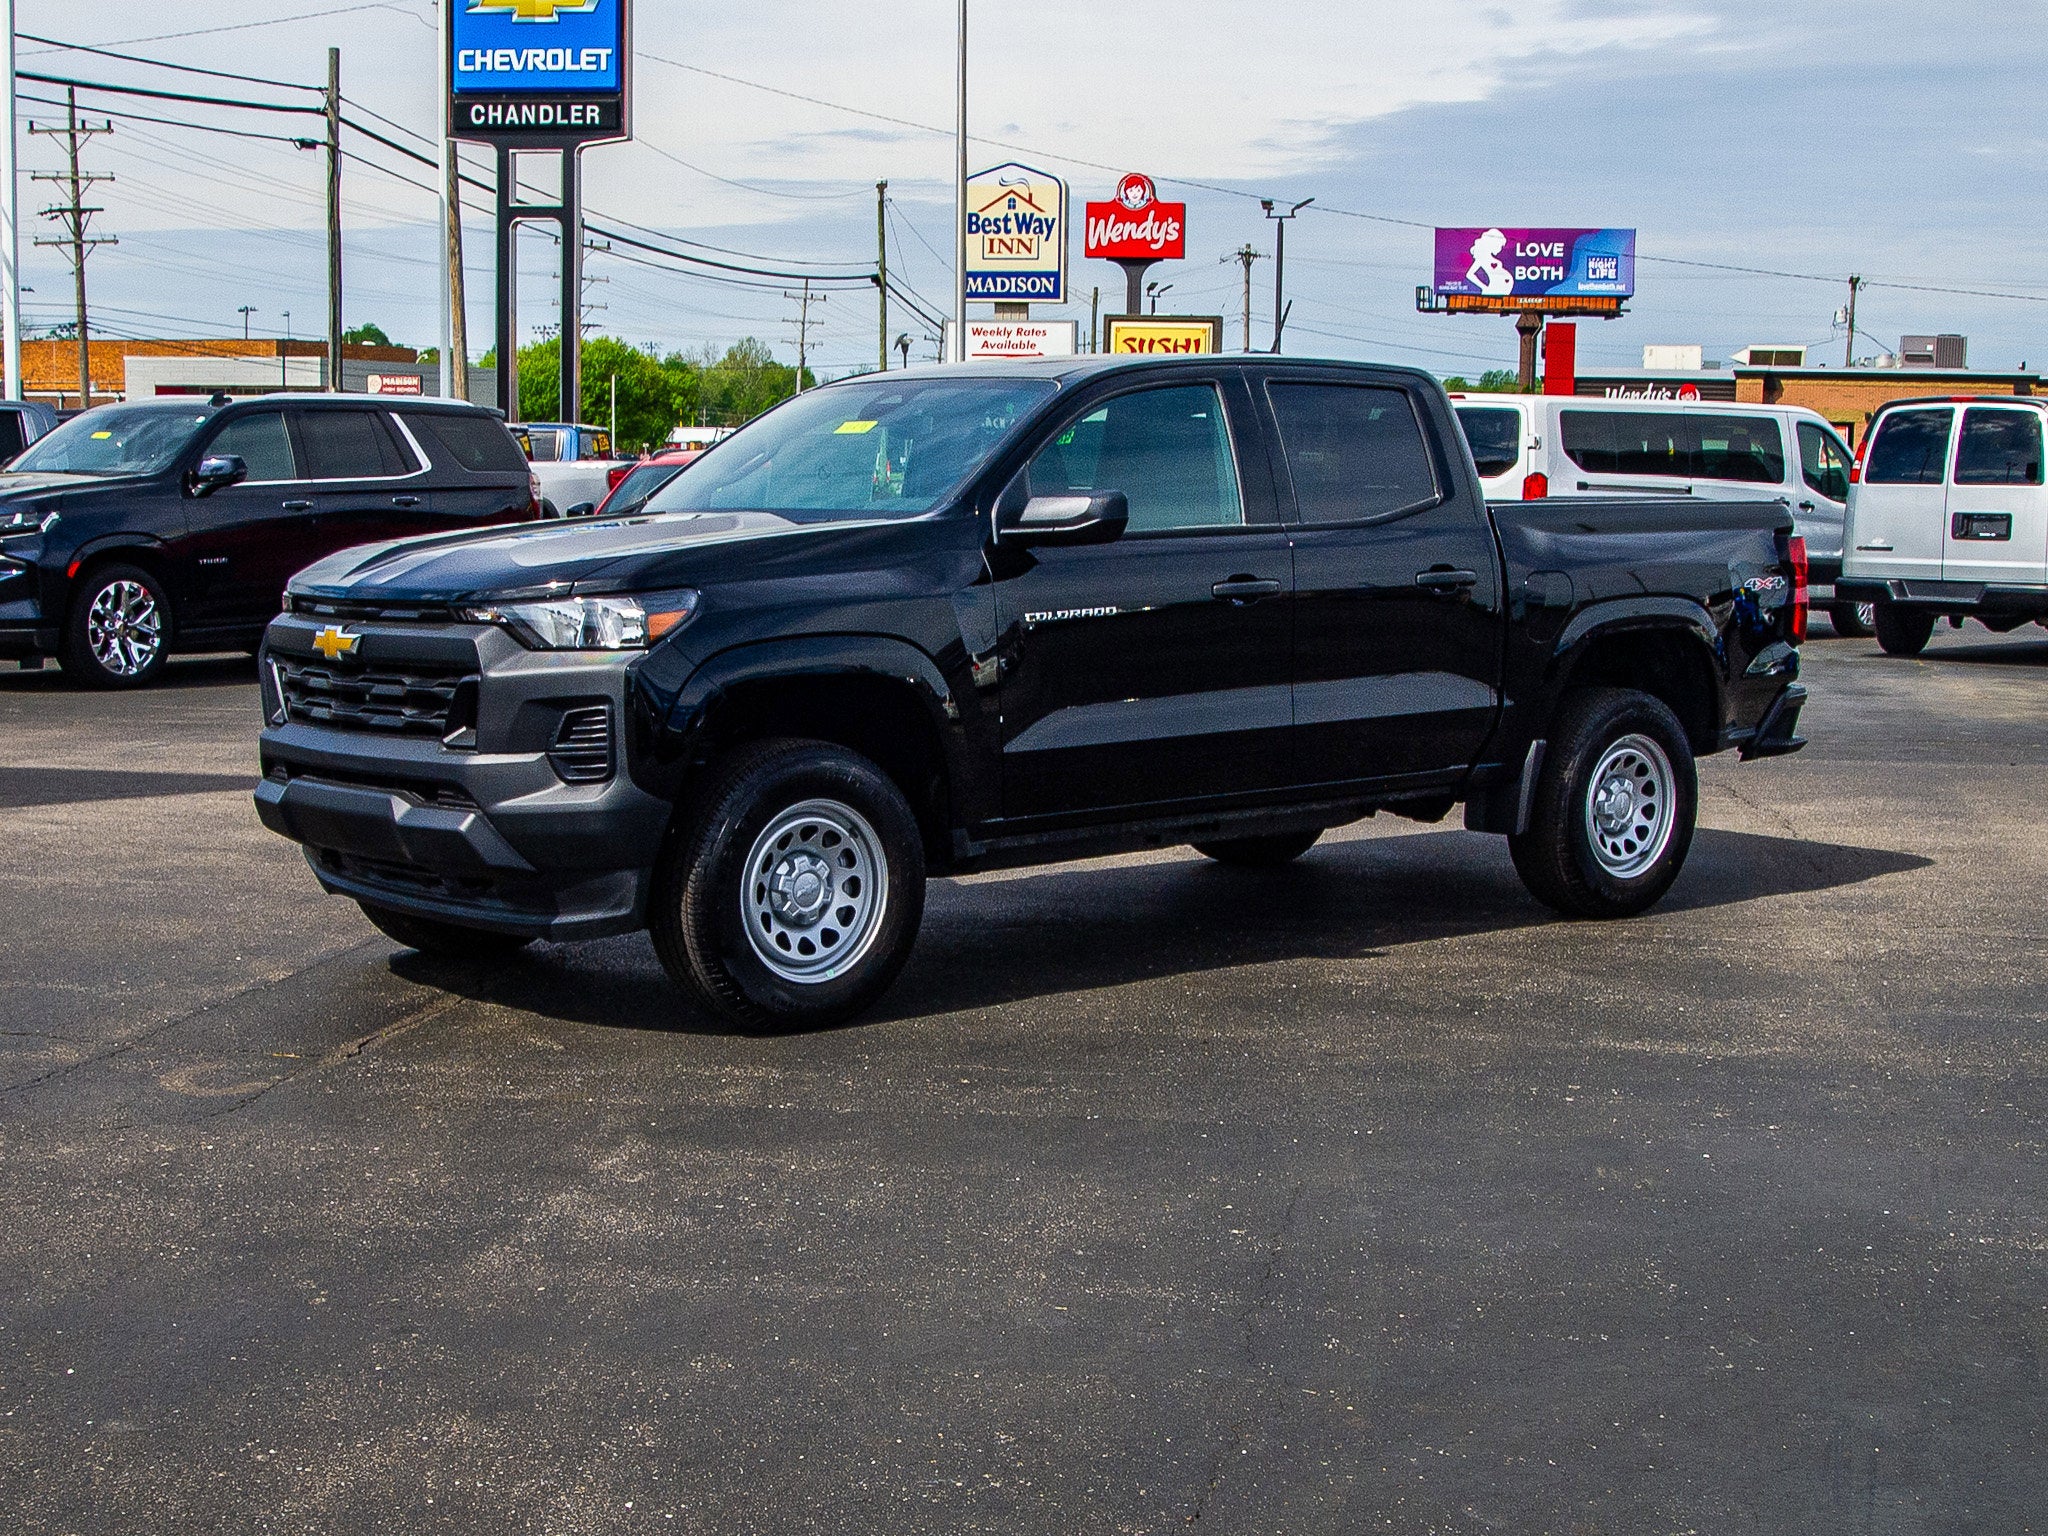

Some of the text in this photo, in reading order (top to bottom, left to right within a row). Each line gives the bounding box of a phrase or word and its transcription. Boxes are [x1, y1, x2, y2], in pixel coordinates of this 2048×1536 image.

[458, 48, 613, 72] CHEVROLET
[470, 104, 601, 125] CHANDLER
[967, 212, 1057, 242] Best Way
[1088, 210, 1181, 250] Wendy's
[987, 237, 1034, 255] INN
[1515, 242, 1565, 257] LOVE
[1514, 266, 1564, 281] BOTH
[1588, 268, 1617, 279] LIFE
[966, 277, 1055, 293] MADISON
[971, 326, 1047, 339] Weekly Rates
[981, 340, 1037, 350] Available
[1122, 337, 1201, 354] SUSHI
[382, 377, 418, 386] MADISON
[1024, 606, 1117, 622] COLORADO
